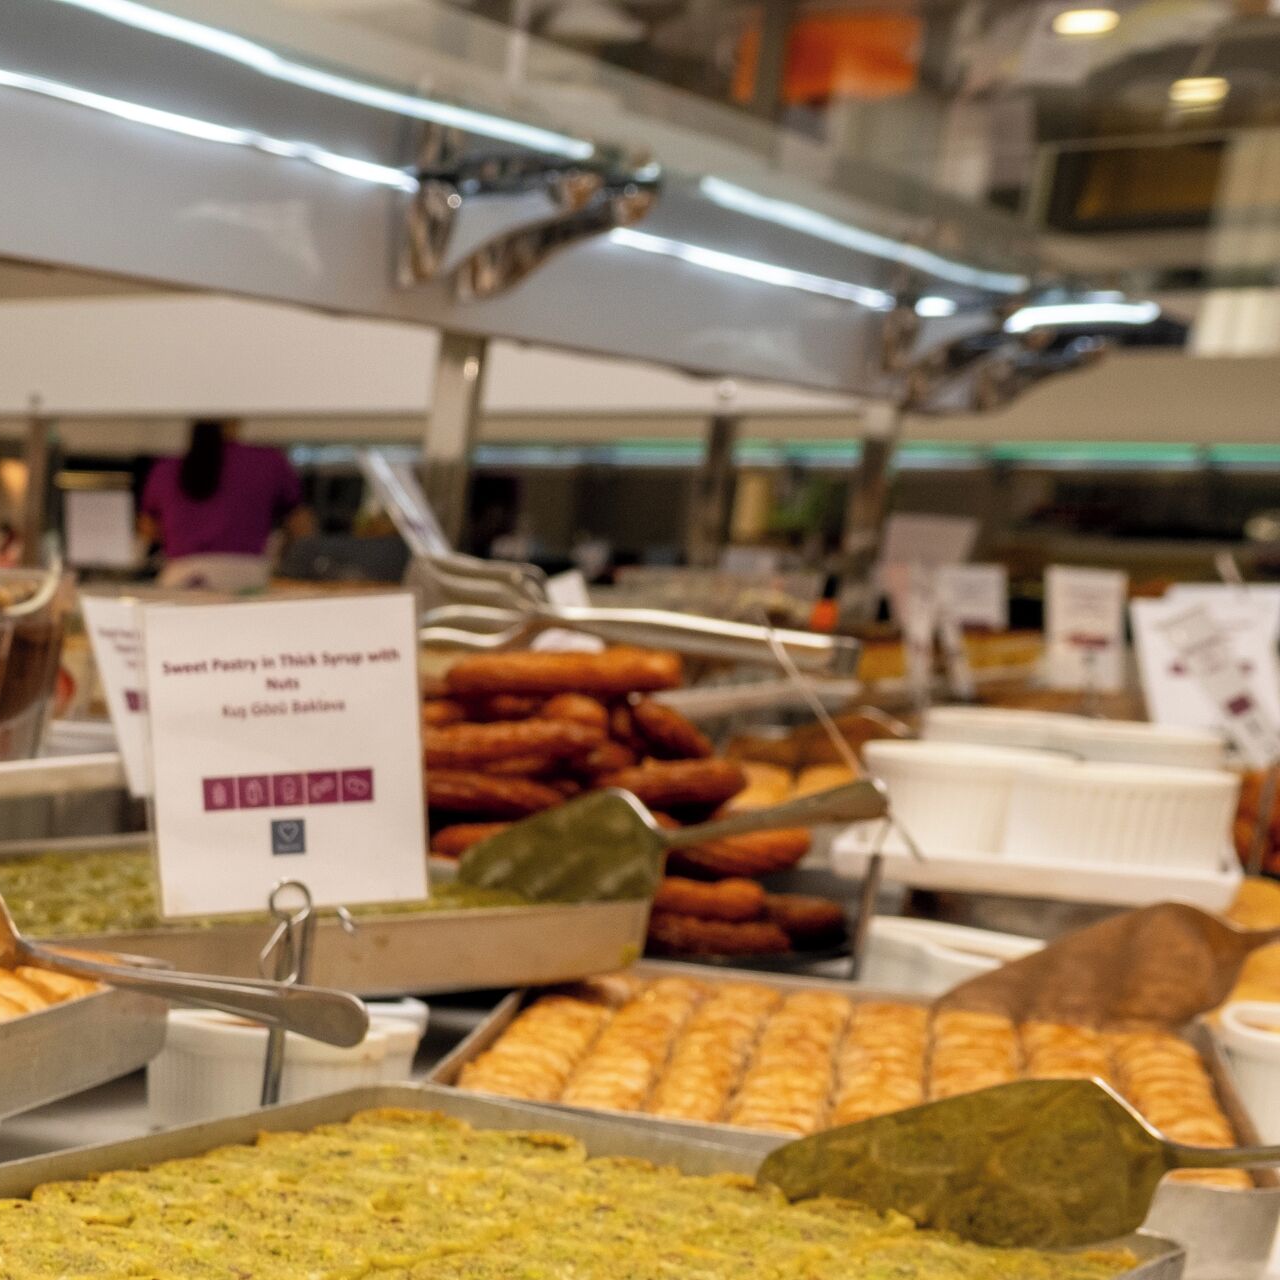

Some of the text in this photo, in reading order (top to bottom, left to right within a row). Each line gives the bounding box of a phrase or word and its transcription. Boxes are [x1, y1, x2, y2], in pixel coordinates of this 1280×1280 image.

[162, 660, 208, 676] Sweet
[212, 658, 257, 676] Pastry
[261, 655, 275, 669] in
[279, 652, 318, 667] Thick
[321, 651, 363, 668] Syrup
[367, 648, 400, 662] with
[265, 677, 300, 690] Nuts
